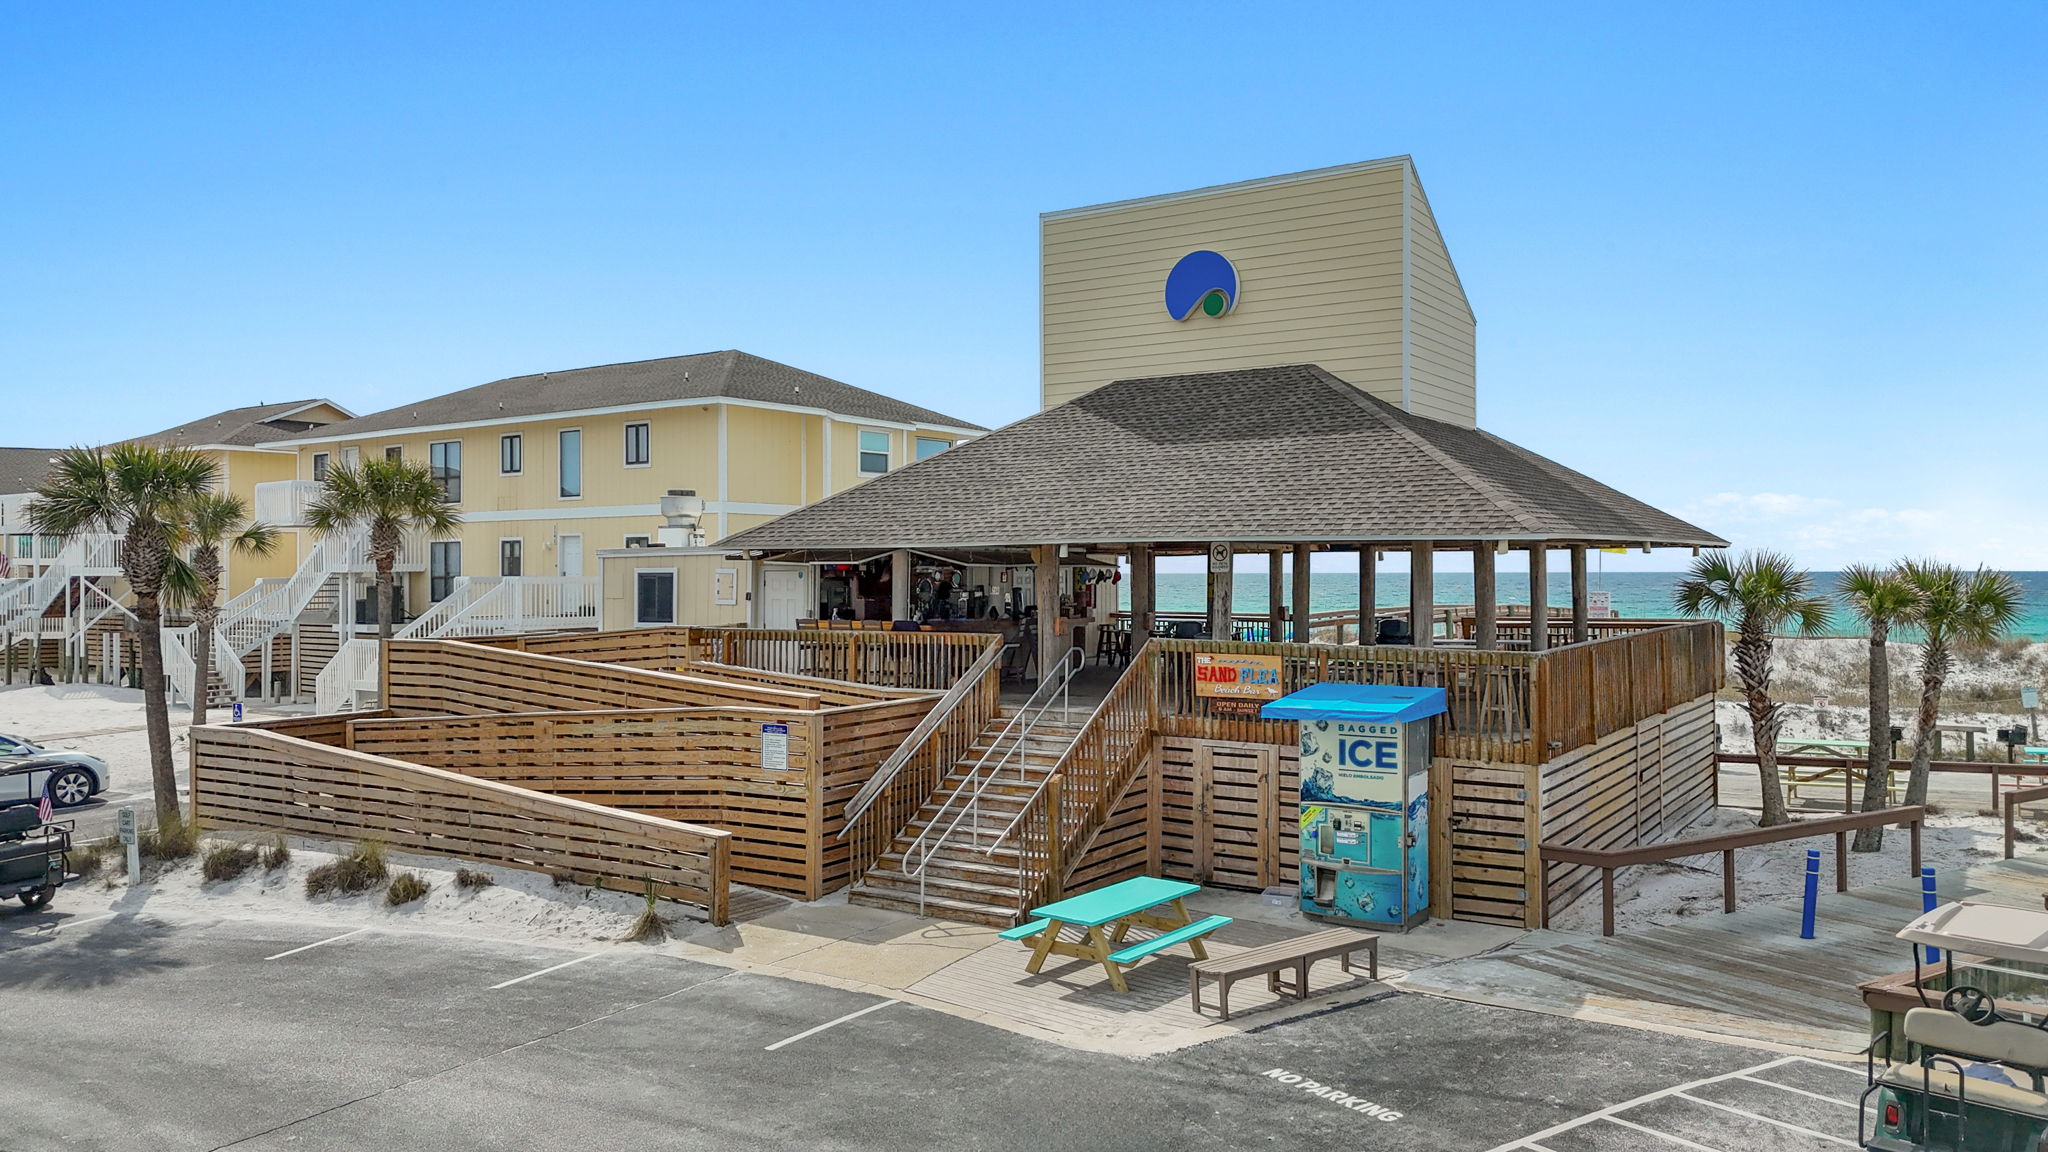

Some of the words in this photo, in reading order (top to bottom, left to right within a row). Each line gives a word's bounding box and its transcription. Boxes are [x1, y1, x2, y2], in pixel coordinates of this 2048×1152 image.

[1197, 666, 1237, 682] SAND
[1240, 668, 1279, 684] FLEA
[1214, 684, 1241, 695] Beach
[1243, 685, 1260, 695] Bar
[1338, 724, 1398, 734] BAGGED
[1338, 738, 1398, 769] ICE
[1262, 1068, 1302, 1083] NO
[1294, 1077, 1404, 1122] PARKING
